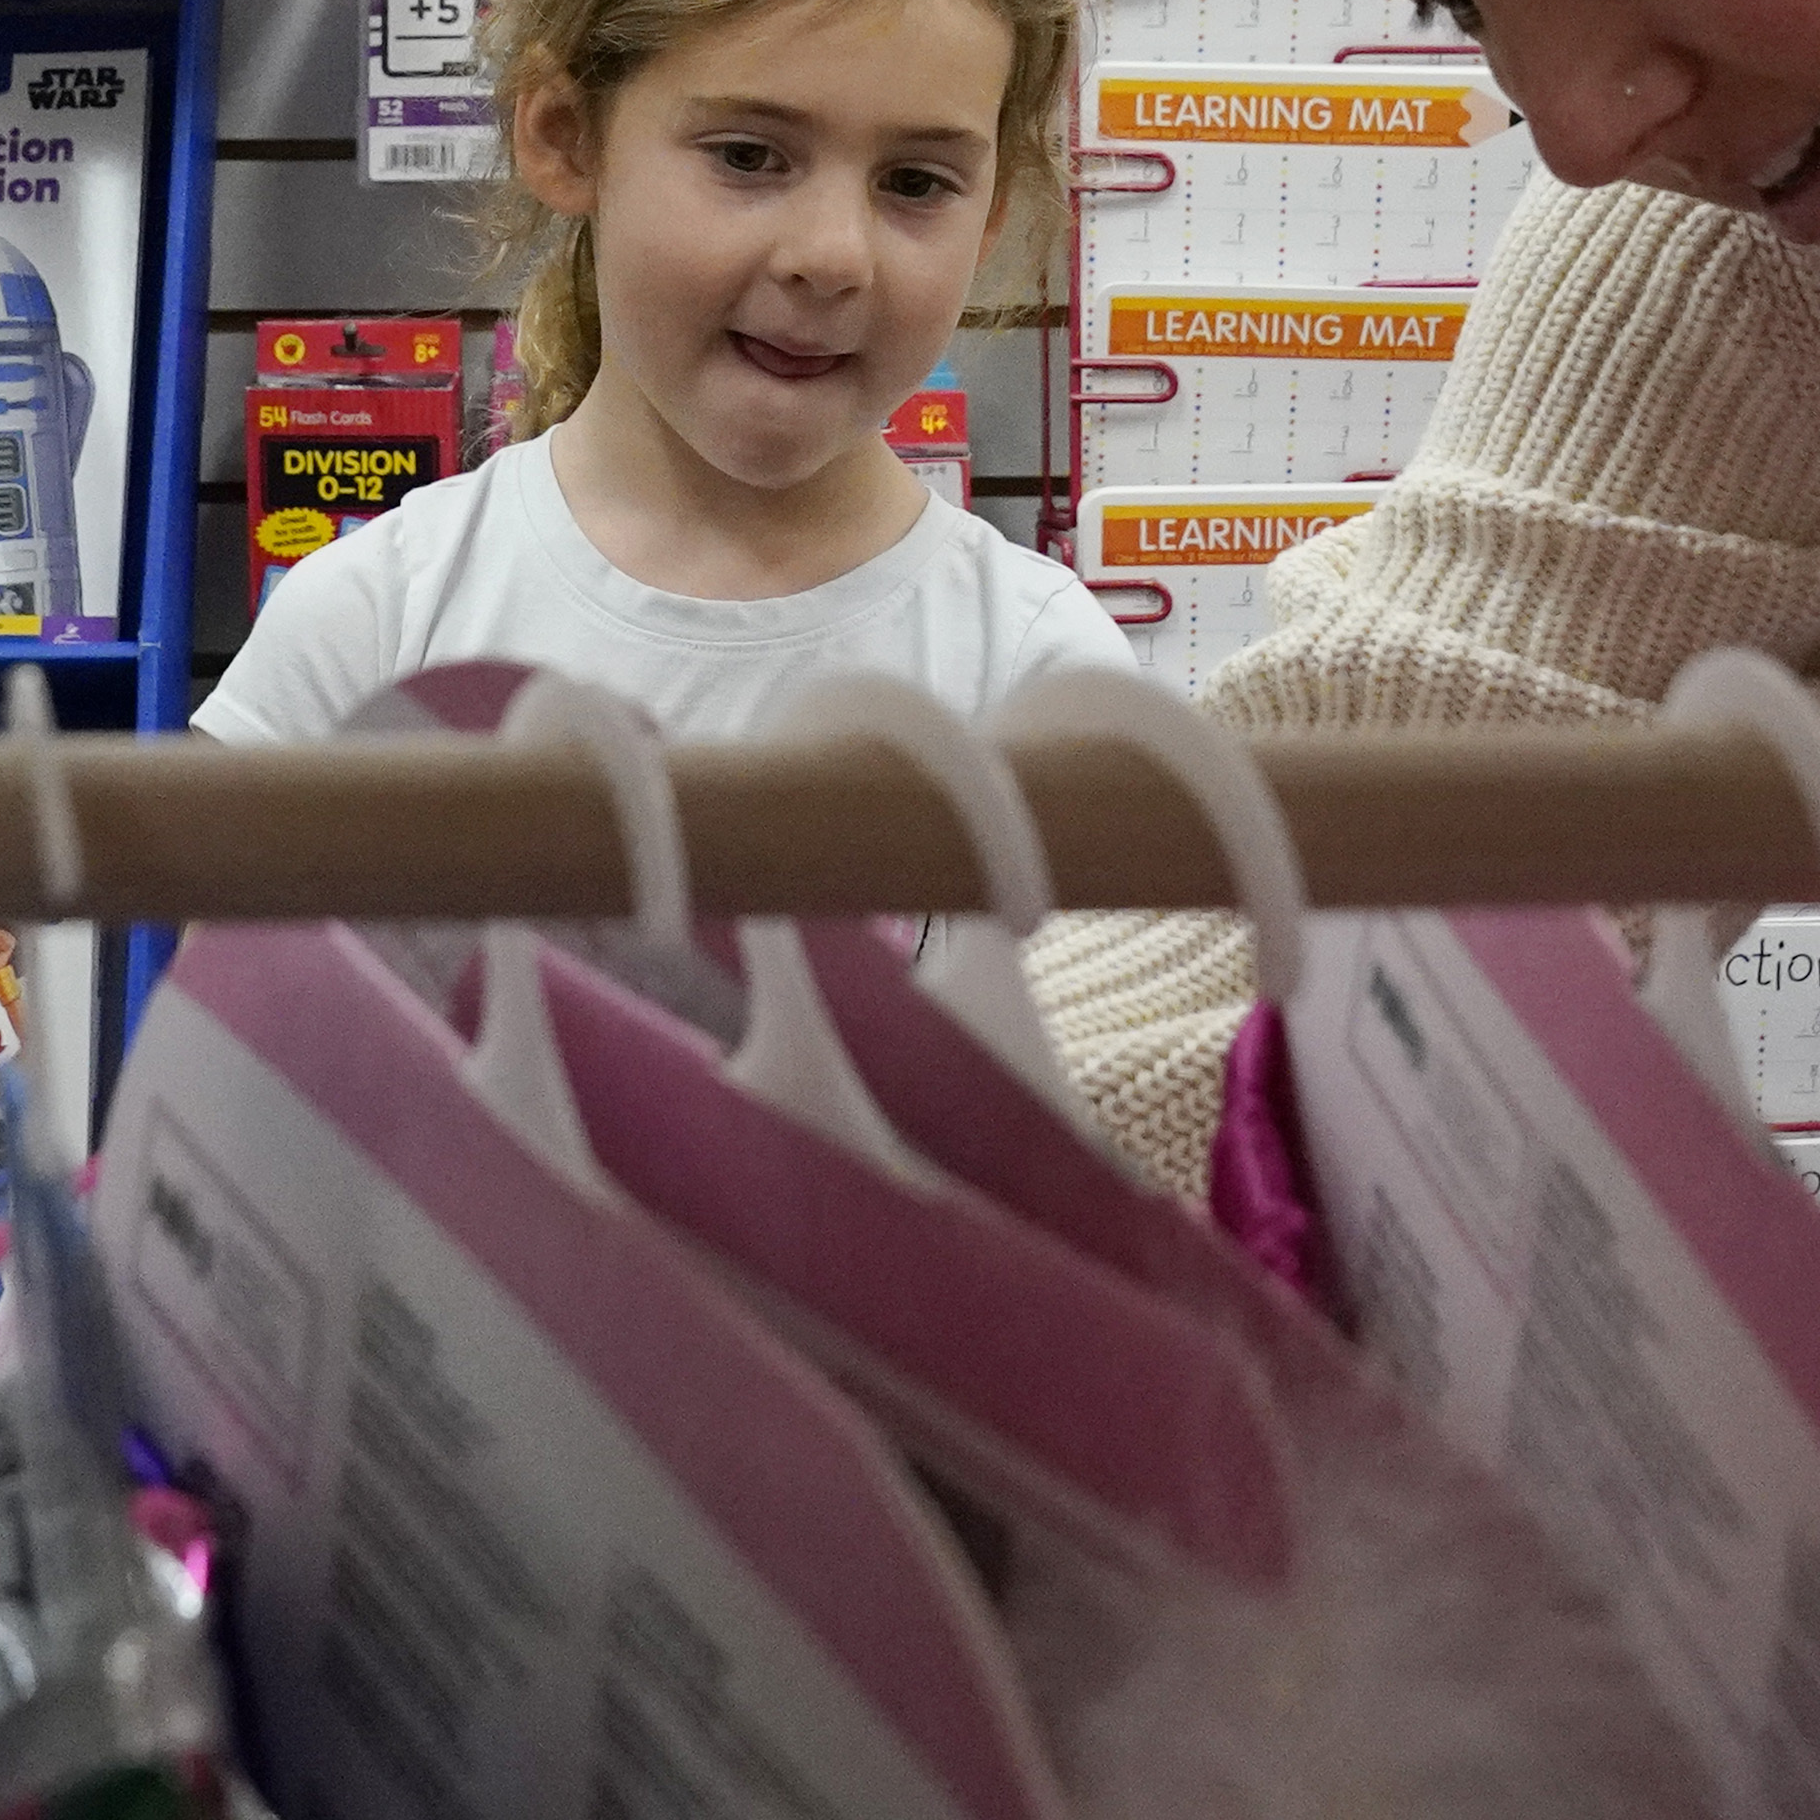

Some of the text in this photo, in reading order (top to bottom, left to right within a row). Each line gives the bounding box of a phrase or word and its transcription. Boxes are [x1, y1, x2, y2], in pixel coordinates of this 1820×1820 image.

[27, 66, 125, 88] STAR
[28, 87, 125, 110] WARS
[378, 100, 404, 117] 52
[1135, 91, 1433, 133] LEARNING MAT
[1145, 310, 1446, 348] LEARNING MAT
[259, 405, 373, 428] 54 Flash Cards
[283, 449, 417, 476] DIVISION
